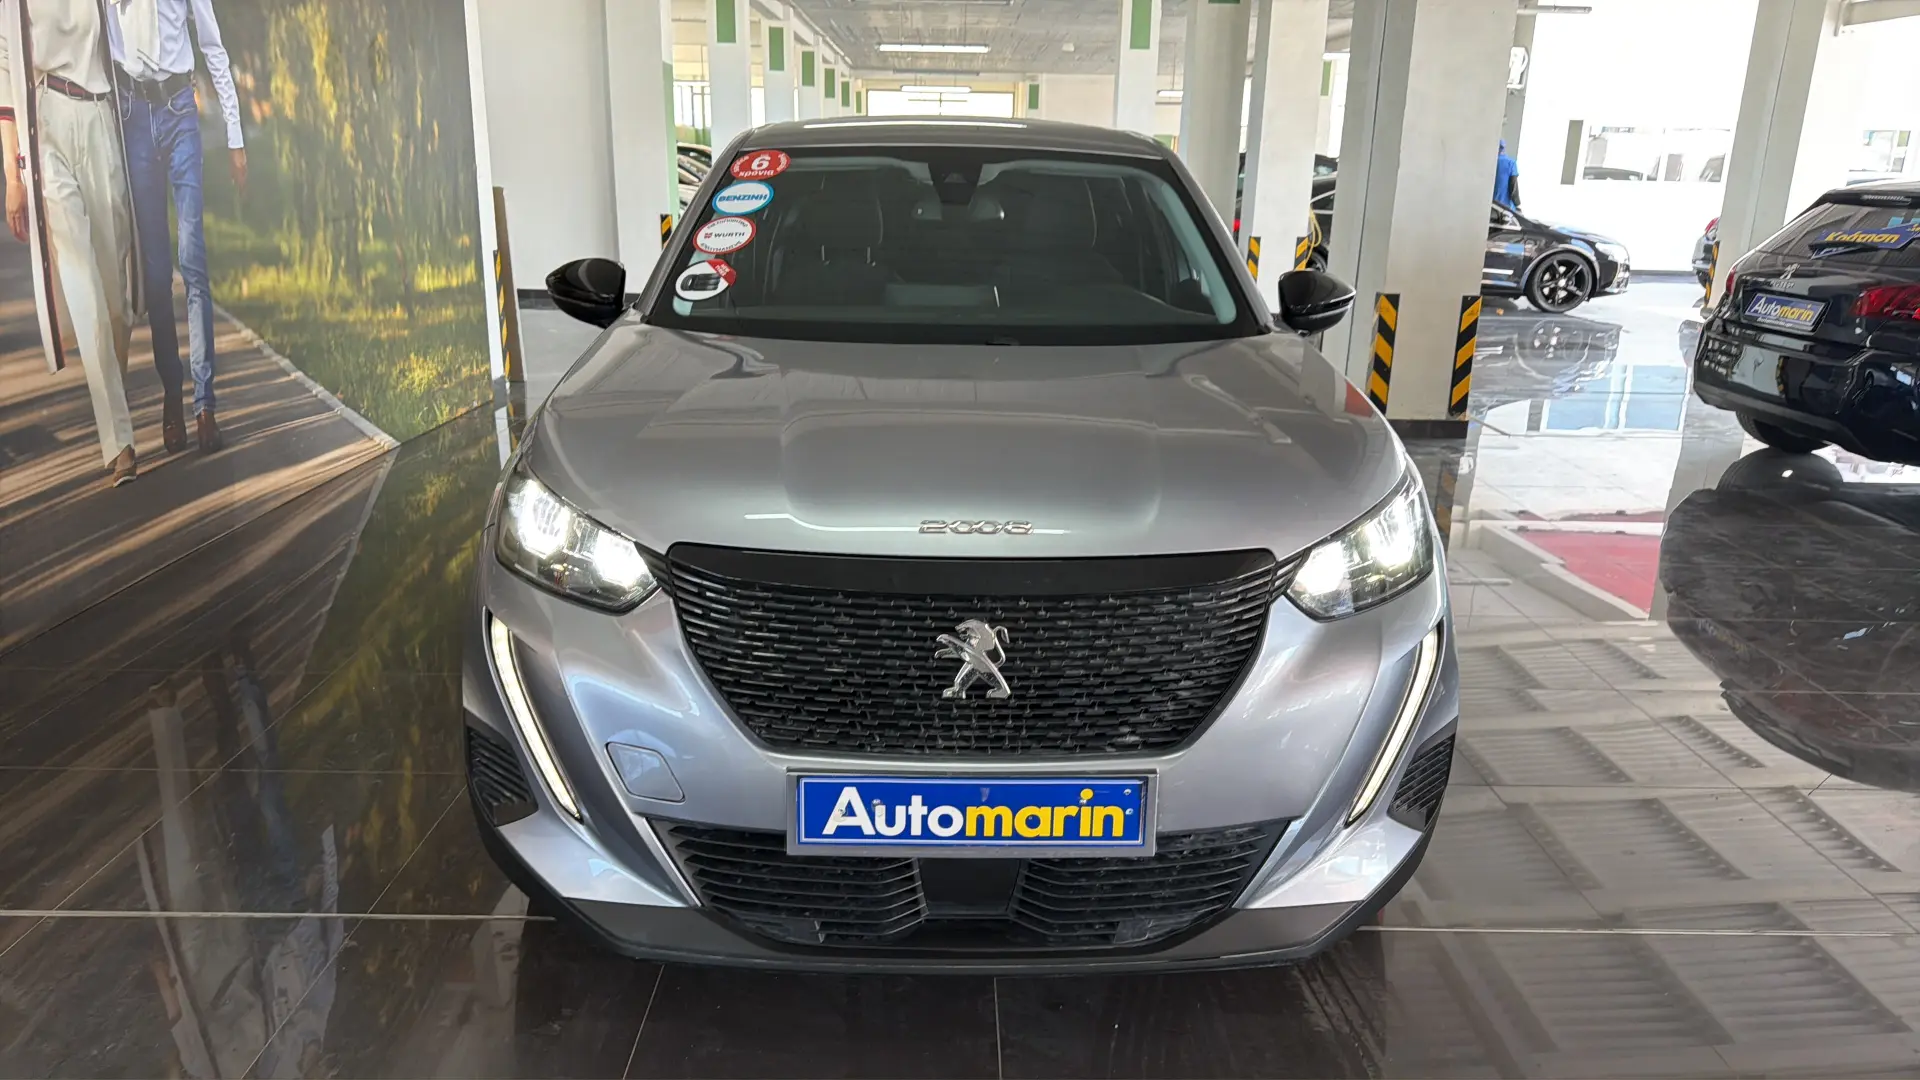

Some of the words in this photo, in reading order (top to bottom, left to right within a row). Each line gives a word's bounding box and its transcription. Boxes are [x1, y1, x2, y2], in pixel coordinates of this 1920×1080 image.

[751, 155, 771, 171] 6
[1750, 296, 1814, 322] Automarin
[918, 519, 1034, 535] 2008
[821, 785, 1124, 837] Automarin
